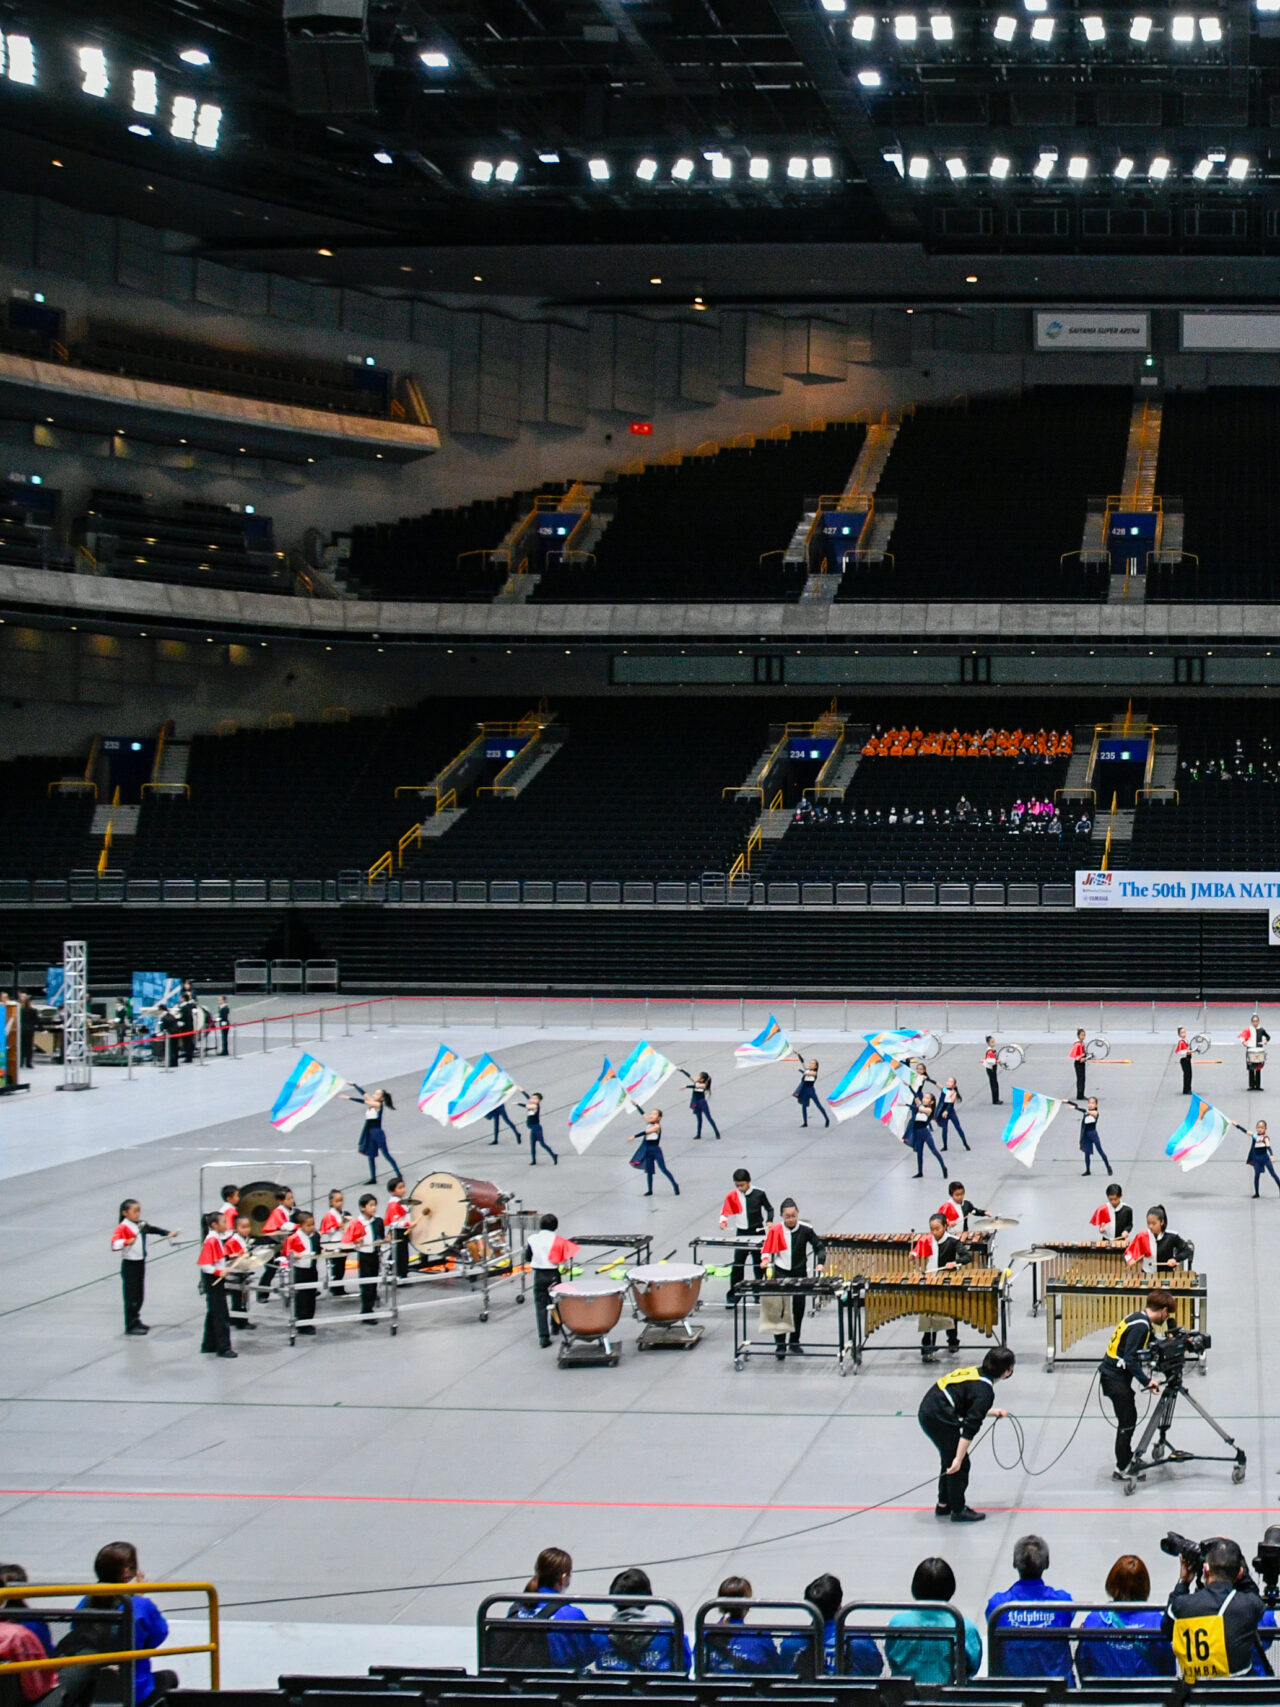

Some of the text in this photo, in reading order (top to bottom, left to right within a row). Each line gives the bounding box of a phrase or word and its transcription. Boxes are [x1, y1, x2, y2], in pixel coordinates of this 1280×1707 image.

[1097, 327, 1119, 335] SUPER
[1119, 327, 1141, 335] ARENA
[789, 750, 805, 759] 234
[1099, 752, 1116, 760] 235
[1119, 881, 1149, 898] The
[1152, 881, 1187, 899] 50th
[1190, 882, 1236, 901] JMBA
[1182, 1627, 1210, 1663] 16
